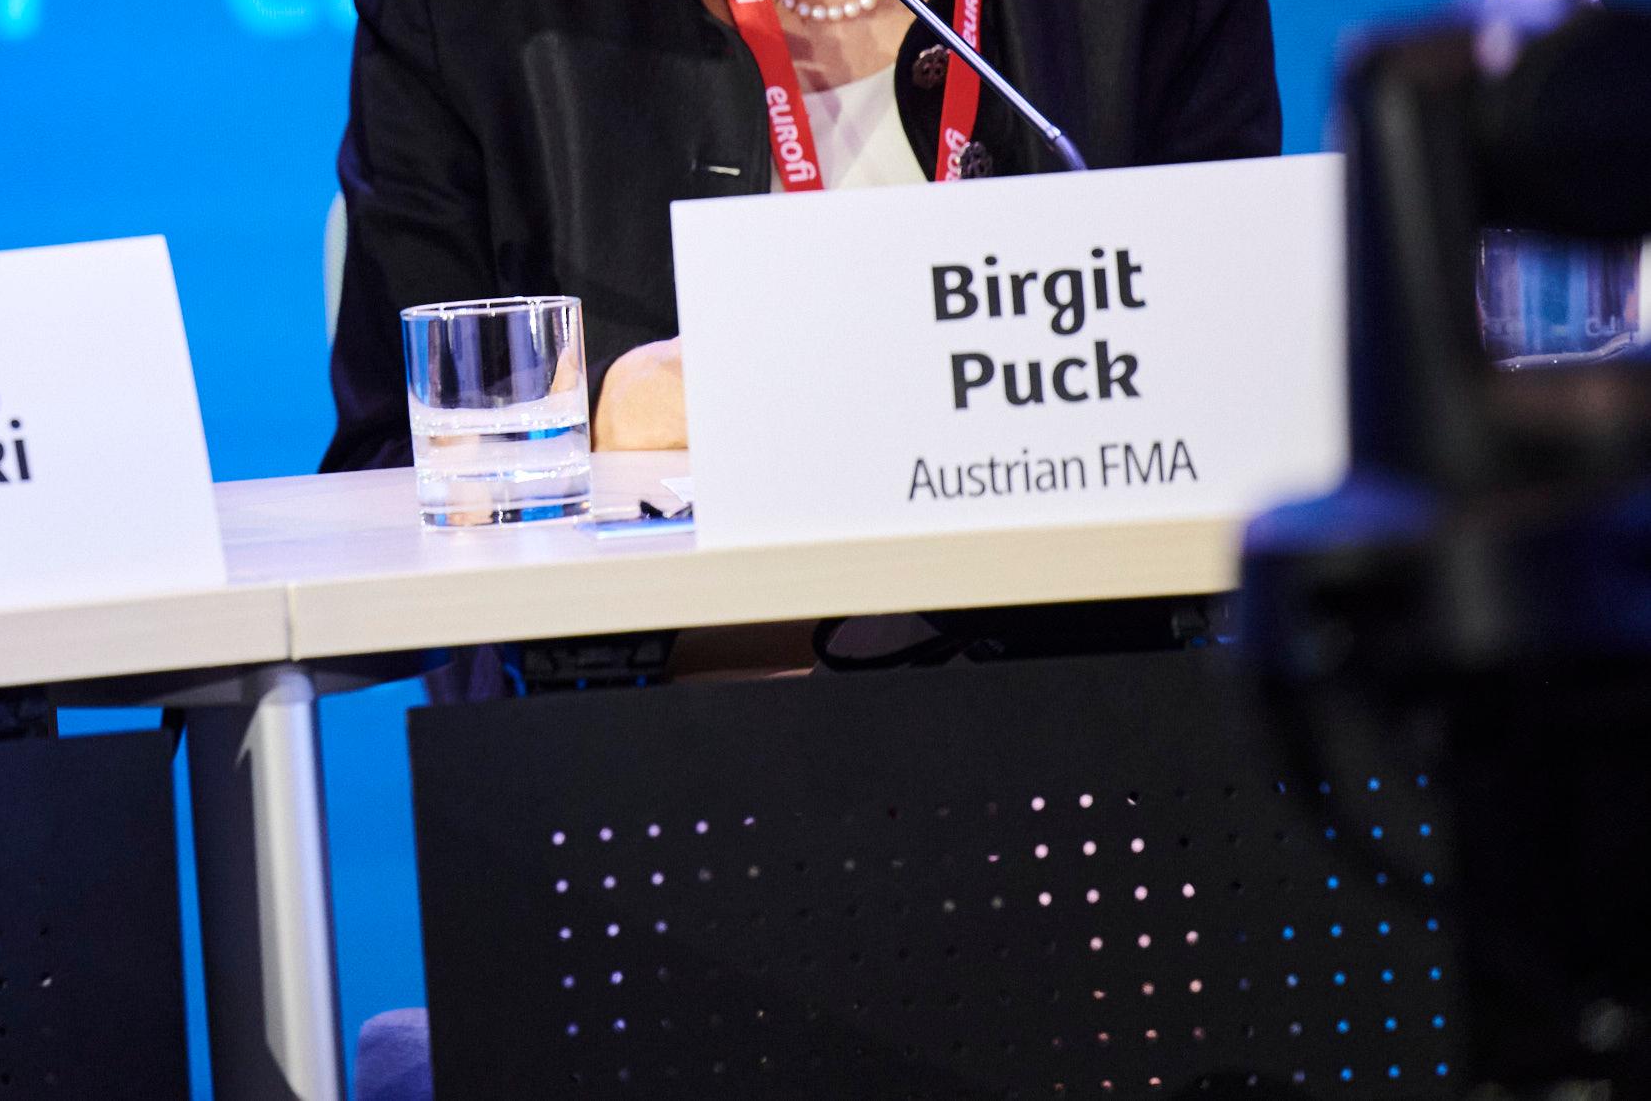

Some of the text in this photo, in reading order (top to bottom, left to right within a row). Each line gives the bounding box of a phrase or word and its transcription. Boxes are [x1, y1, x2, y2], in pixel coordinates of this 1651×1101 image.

[931, 247, 1147, 336] Birgit
[950, 339, 1141, 411] Puck
[908, 439, 1198, 502] Austrian FMA
